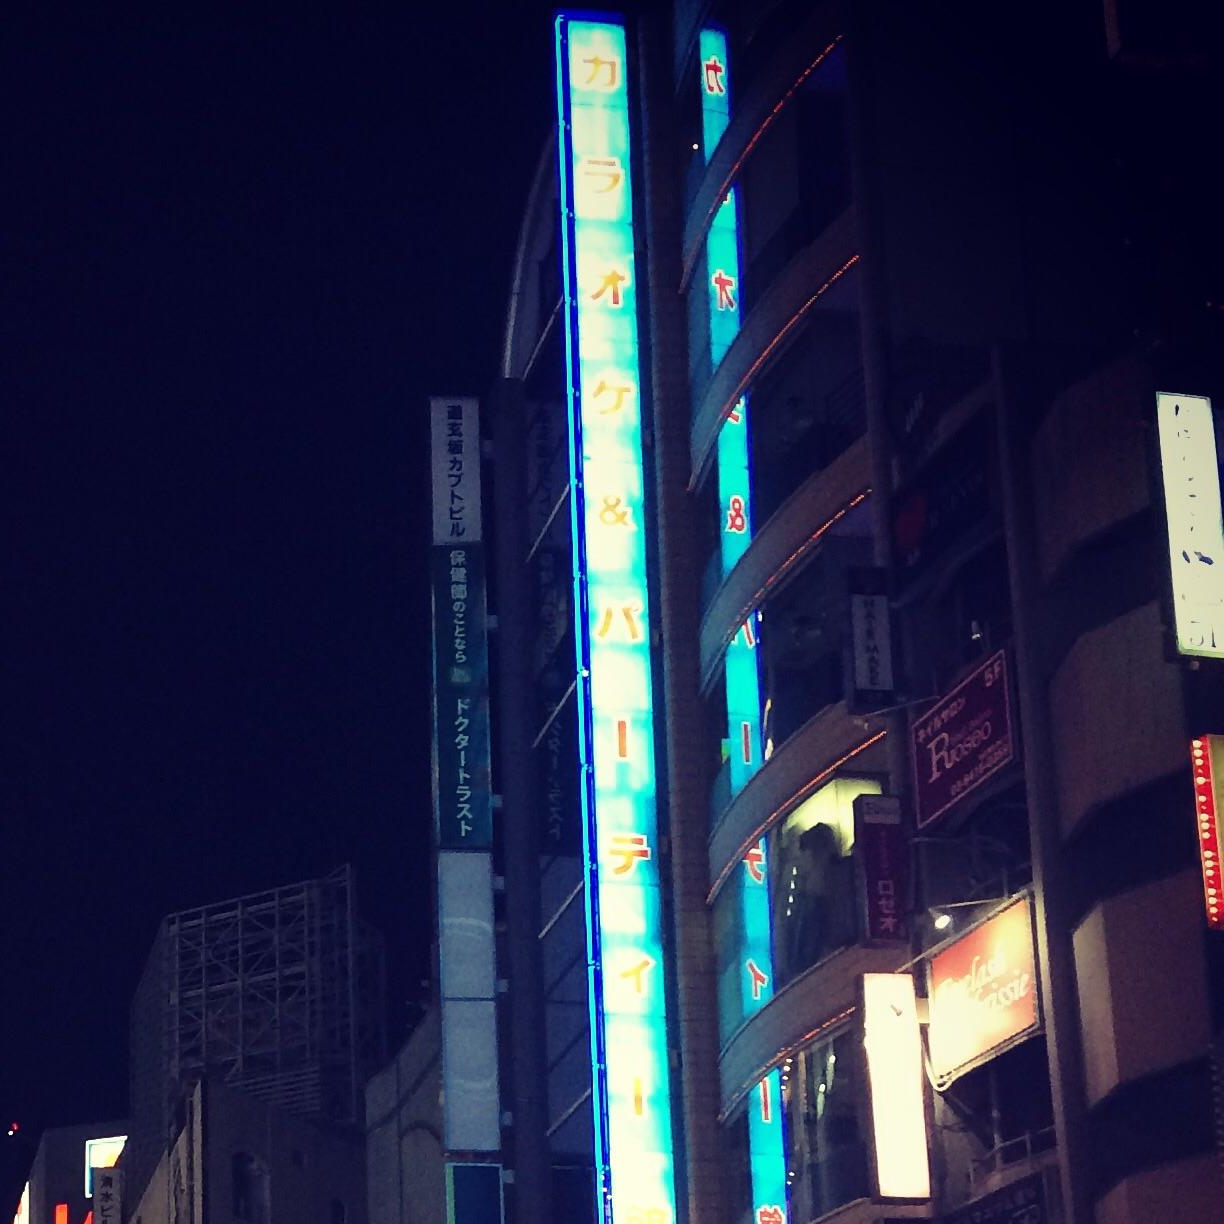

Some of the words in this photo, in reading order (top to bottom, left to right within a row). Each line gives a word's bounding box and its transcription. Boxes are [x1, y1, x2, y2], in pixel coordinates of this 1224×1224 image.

[454, 698, 473, 837] ドクタートラスト
